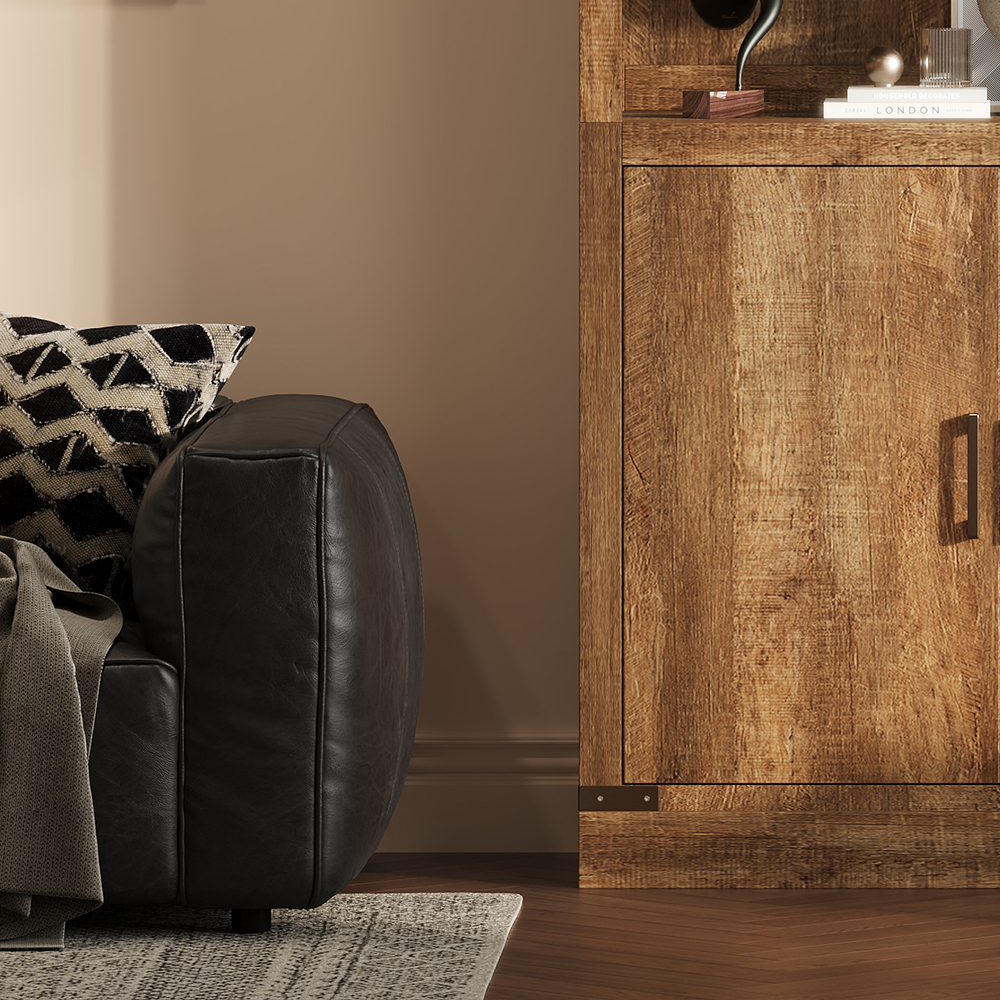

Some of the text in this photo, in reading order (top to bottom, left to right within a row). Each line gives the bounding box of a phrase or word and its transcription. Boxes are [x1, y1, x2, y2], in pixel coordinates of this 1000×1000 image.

[873, 92, 961, 100] HOUSEHOLD DECORATES
[876, 106, 940, 115] LONDON
